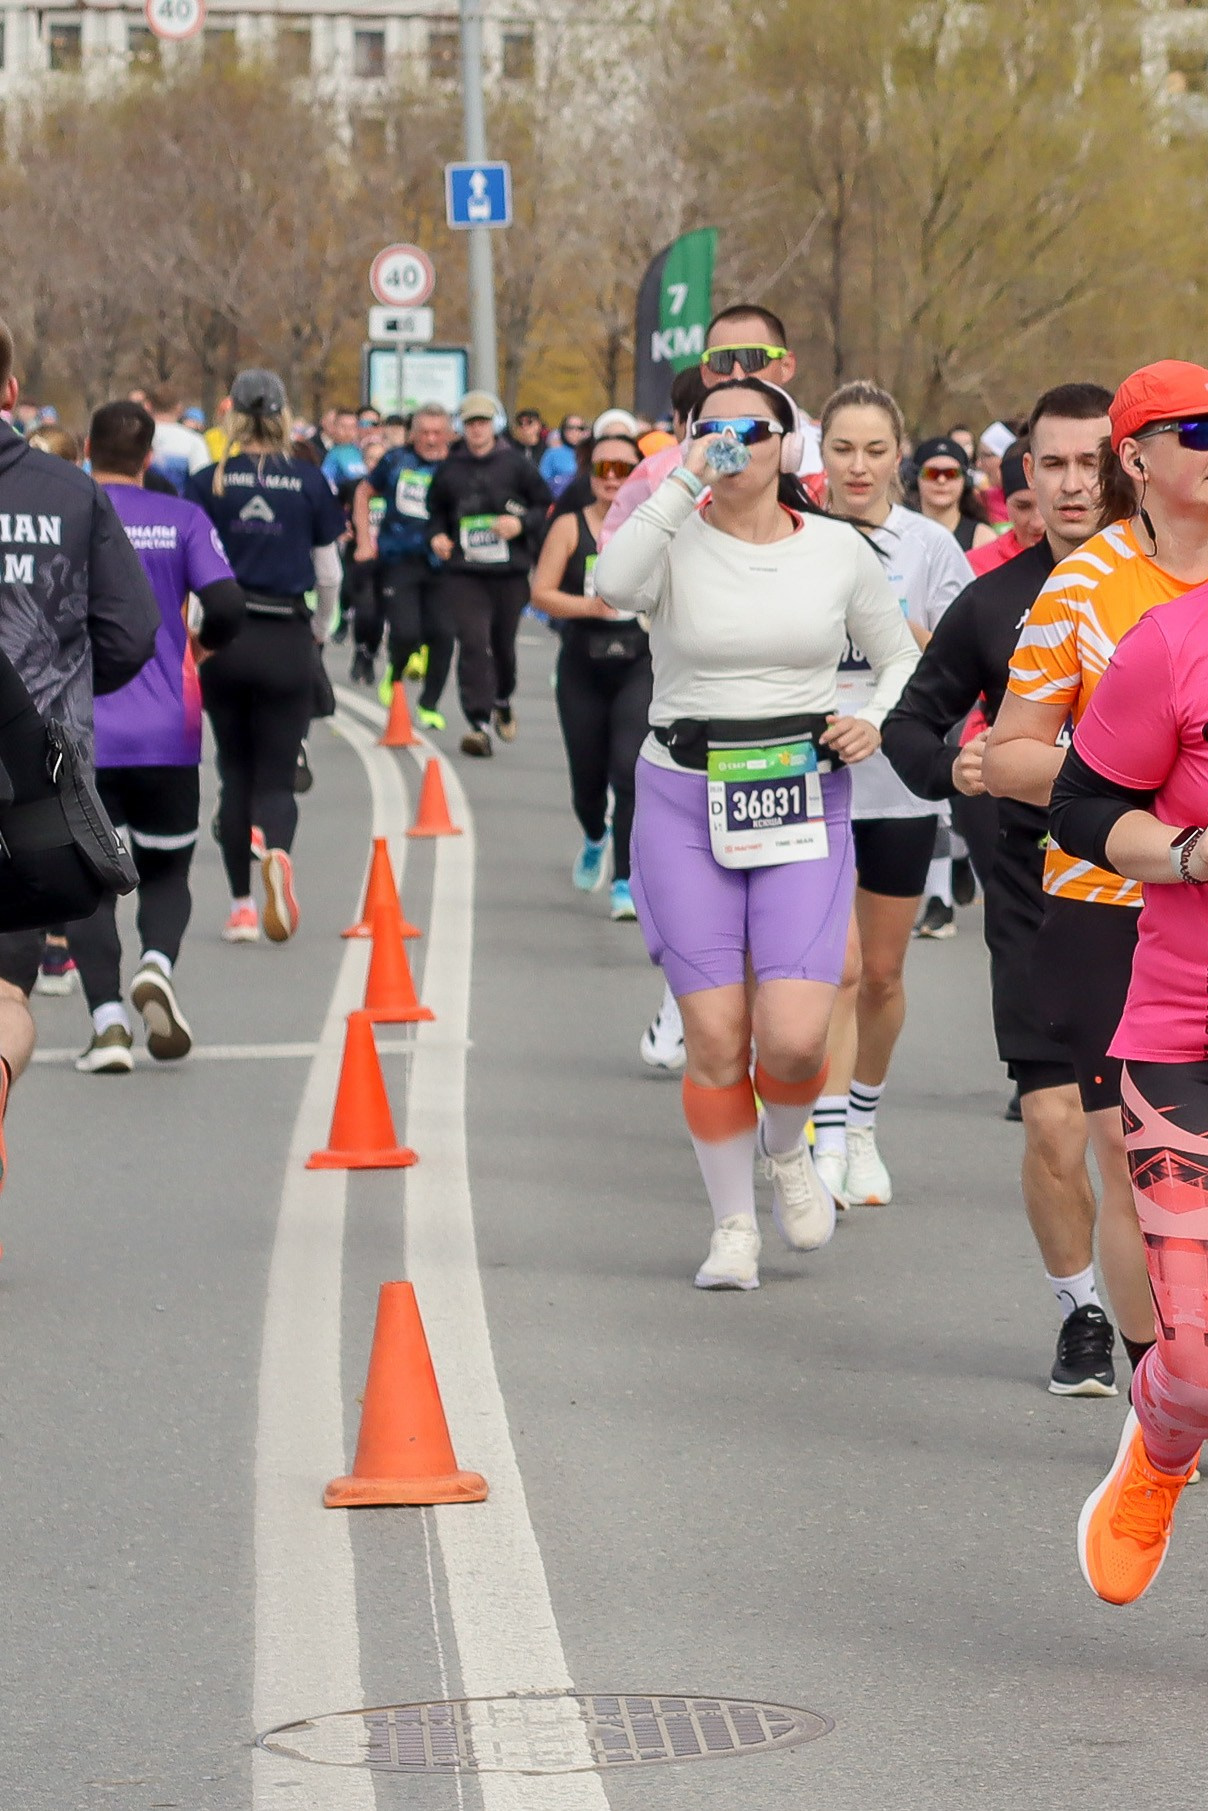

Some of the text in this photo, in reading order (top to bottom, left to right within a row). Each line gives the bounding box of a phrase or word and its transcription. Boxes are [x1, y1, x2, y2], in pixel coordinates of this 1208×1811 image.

[158, 0, 191, 18] 40
[385, 264, 419, 288] 40
[667, 282, 688, 315] 7
[712, 801, 723, 815] D
[732, 785, 800, 821] 36831
